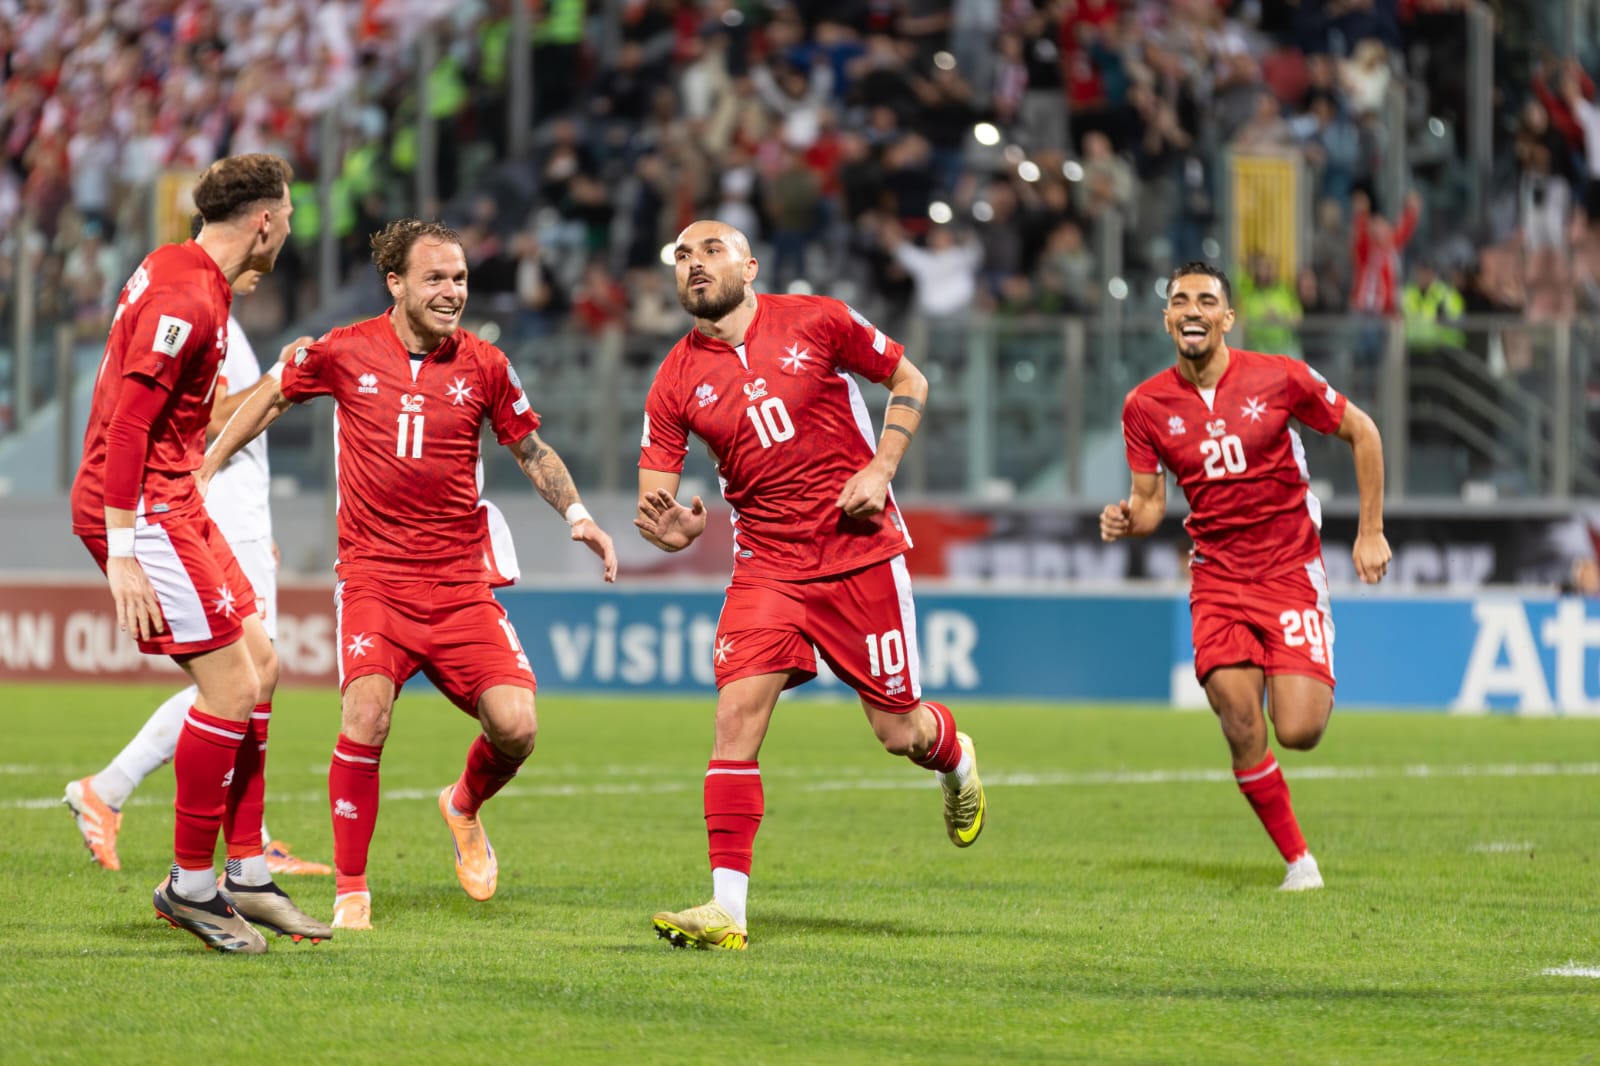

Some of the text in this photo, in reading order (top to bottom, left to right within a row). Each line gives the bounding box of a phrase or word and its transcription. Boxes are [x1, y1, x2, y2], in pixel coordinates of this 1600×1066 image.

[396, 413, 425, 459] 11
[746, 397, 796, 449] 10
[1200, 434, 1248, 479] 20
[549, 603, 716, 685] visit
[1279, 608, 1323, 647] 20
[865, 629, 905, 677] 10
[1450, 597, 1600, 715] At
